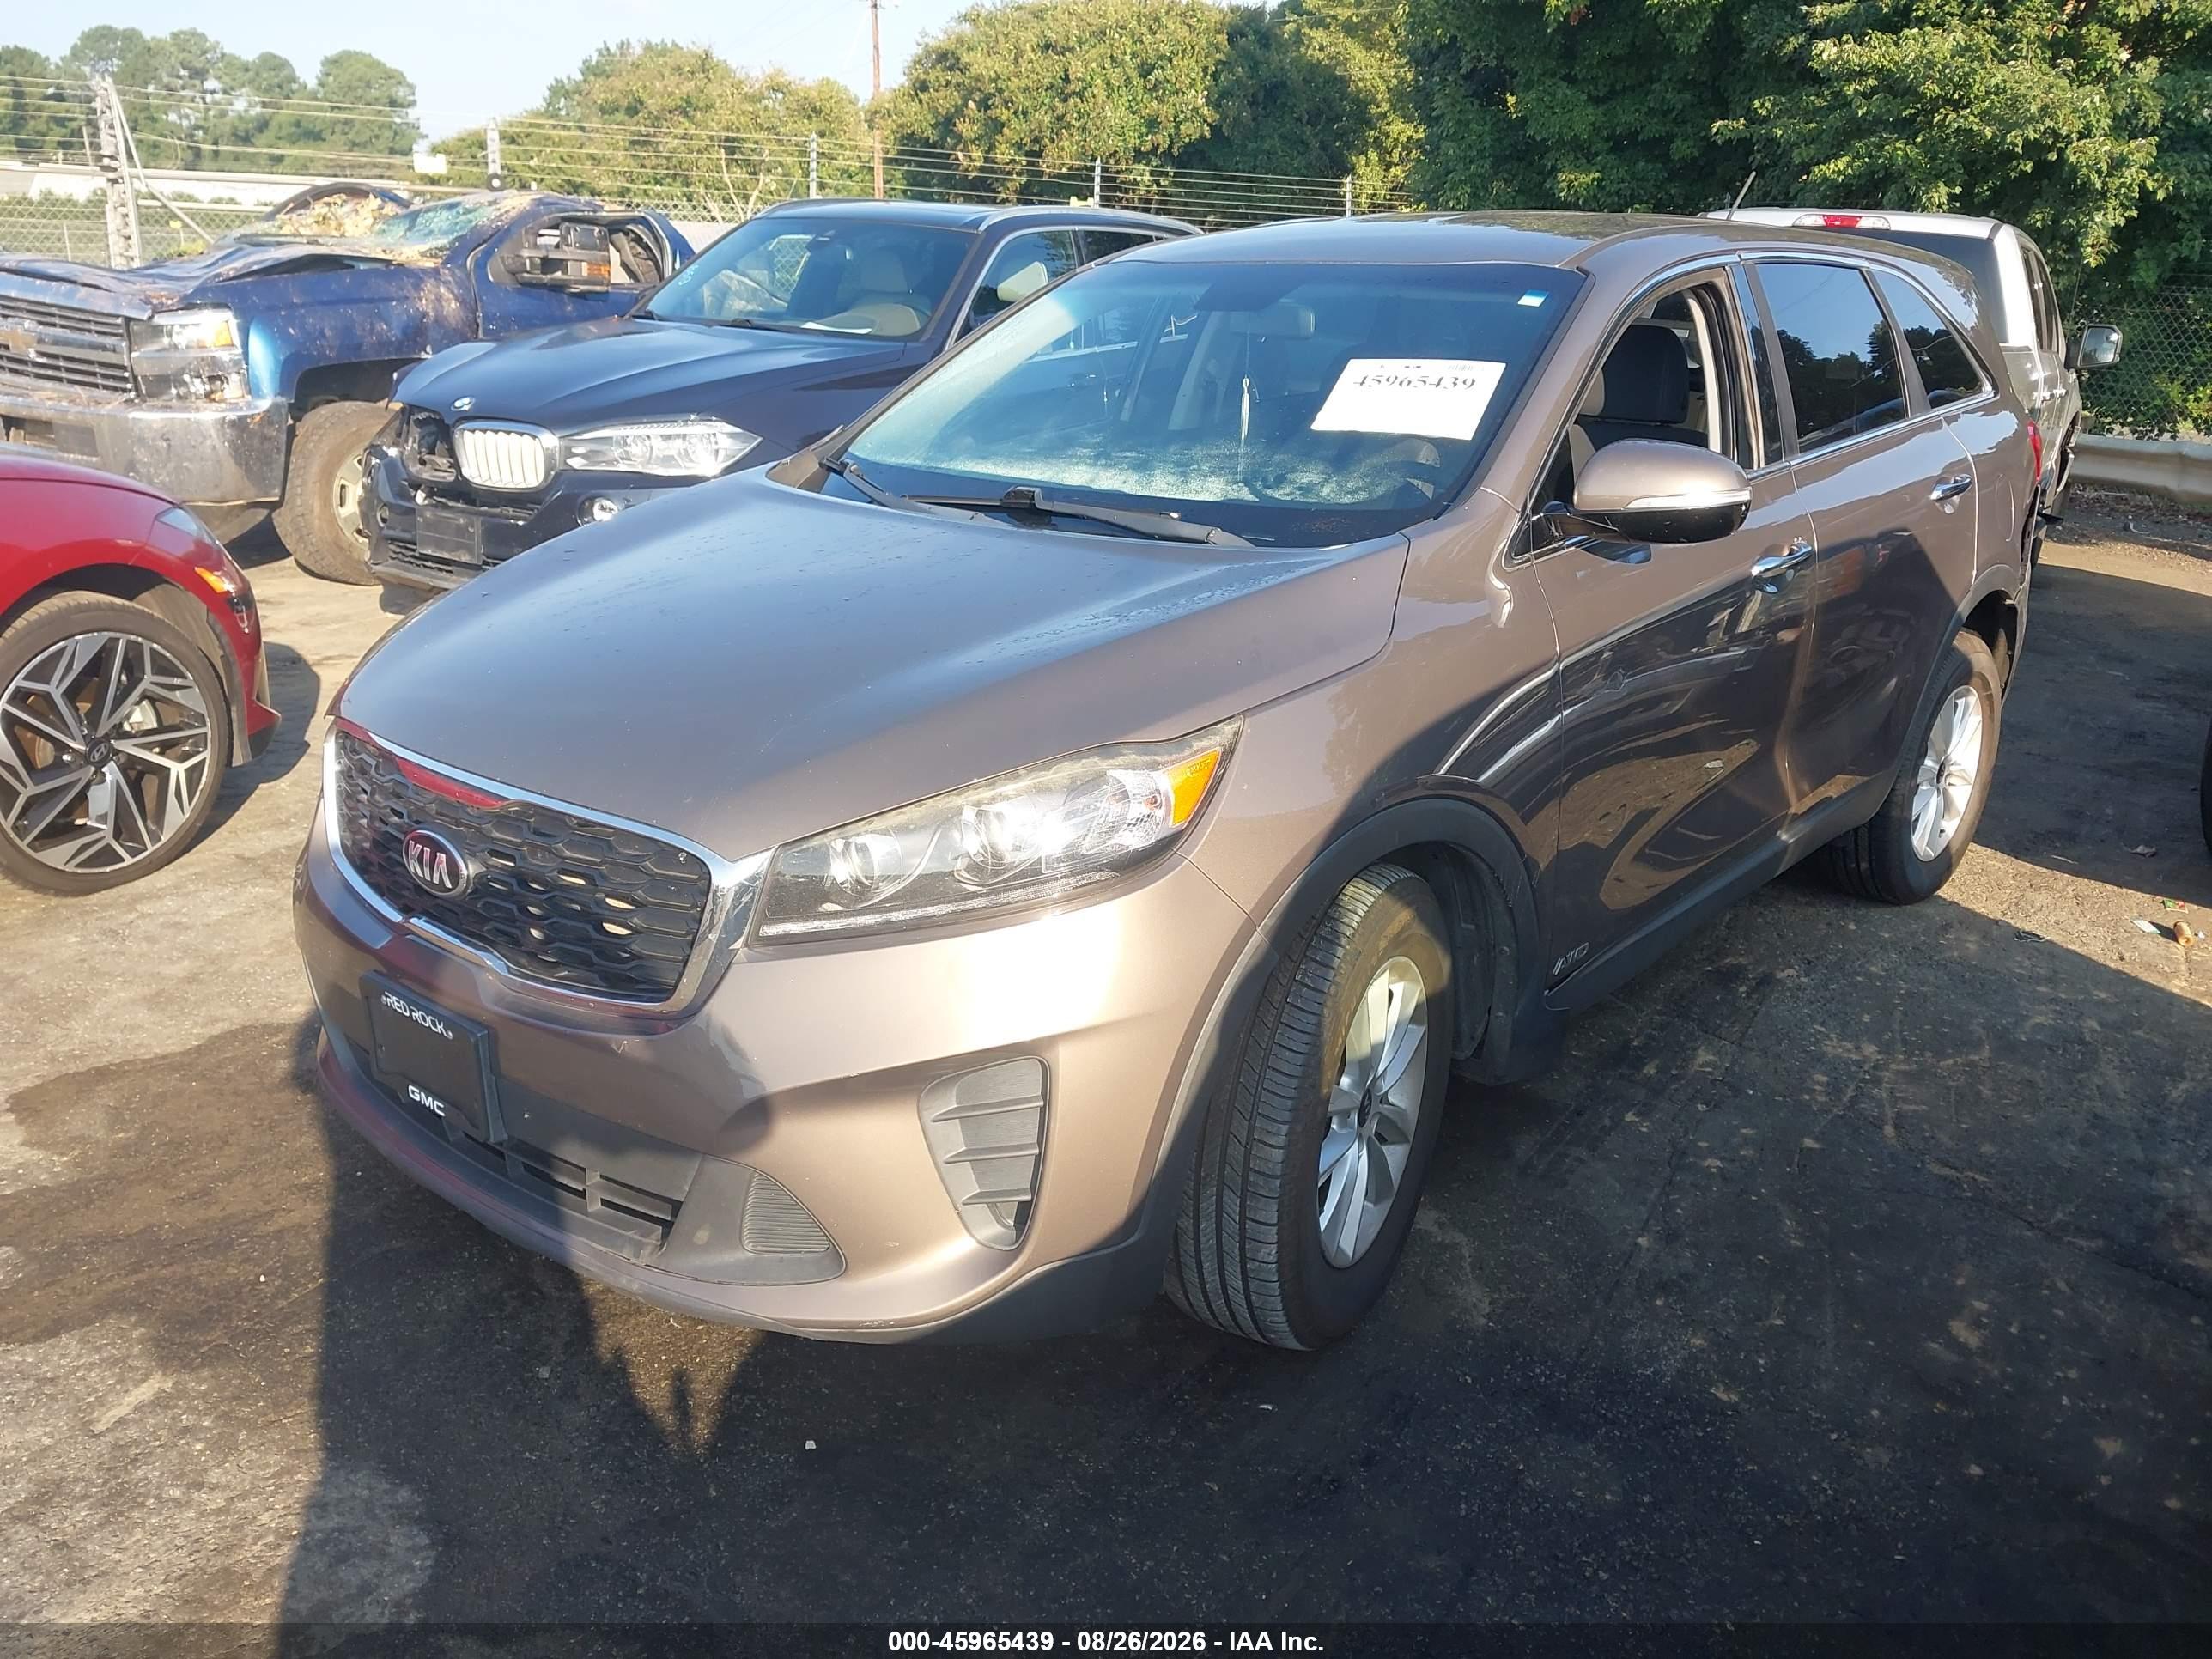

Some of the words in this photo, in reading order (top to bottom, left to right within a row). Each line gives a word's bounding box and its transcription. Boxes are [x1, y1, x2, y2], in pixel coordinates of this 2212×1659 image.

[1353, 374, 1476, 389] 45965439
[408, 839, 453, 889] KIA
[385, 991, 410, 1017] RED
[410, 1006, 447, 1036] ROCK
[408, 1085, 446, 1116] GMC
